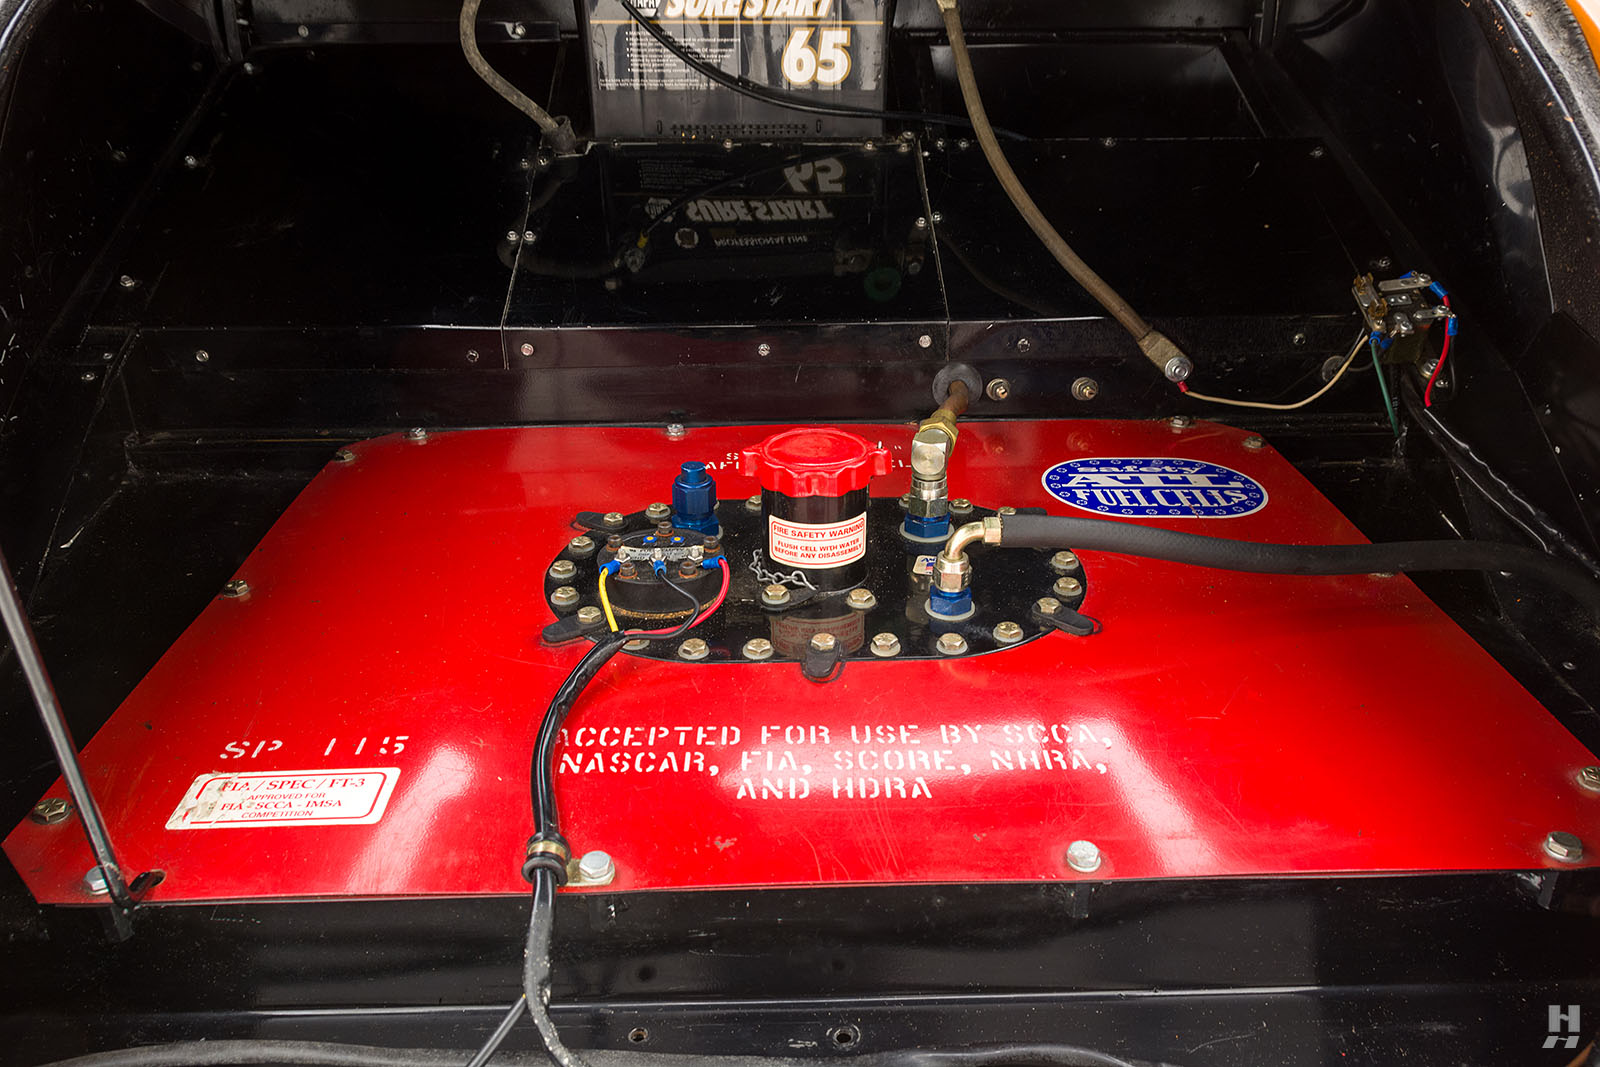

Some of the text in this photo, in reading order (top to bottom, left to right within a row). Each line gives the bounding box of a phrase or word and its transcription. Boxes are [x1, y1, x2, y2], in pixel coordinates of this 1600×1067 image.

[781, 27, 851, 85] 65
[1061, 473, 1245, 489] ATL
[774, 521, 865, 539] FIRE SAFETY WARNING
[774, 546, 798, 557] BEFORE
[818, 543, 862, 559] DISASSEMBLY
[777, 540, 798, 550] FLUSH
[839, 537, 860, 549] WATER
[556, 724, 1113, 749] ACCEPTED FOR USE BY SCCA,
[559, 750, 1107, 776] NASCAR, FIA, SCORE, NHRA,
[736, 777, 932, 800] AND HDRA
[247, 793, 302, 801] APPROVED
[220, 803, 243, 811] FIA
[256, 801, 294, 809] SCCA
[305, 800, 342, 808] IMSA
[241, 810, 313, 819] COMPETITION
